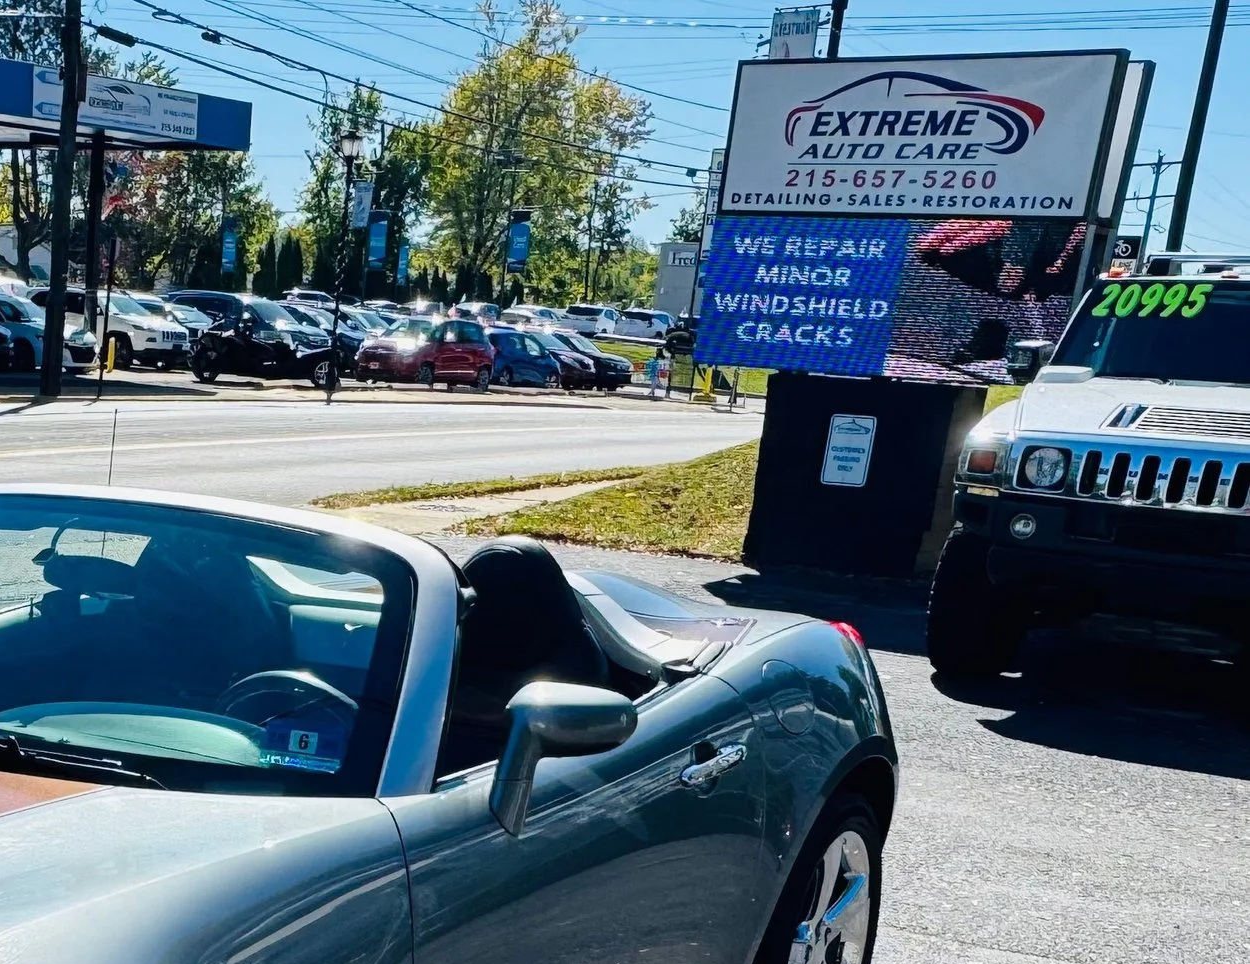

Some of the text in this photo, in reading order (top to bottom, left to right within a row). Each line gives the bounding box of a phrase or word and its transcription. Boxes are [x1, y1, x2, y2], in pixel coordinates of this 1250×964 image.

[809, 110, 980, 137] EXTREME
[798, 143, 984, 160] AUTO CARE
[785, 168, 998, 190] 215-657-5260
[731, 192, 1074, 210] DETAILING SALES RESTORATION
[734, 235, 887, 259] WE REPAIR
[754, 264, 851, 287] MINOR
[714, 291, 890, 320] WINDSHIELD
[1091, 282, 1214, 319] 20995
[736, 321, 854, 348] CRACKS
[298, 733, 310, 750] 6
